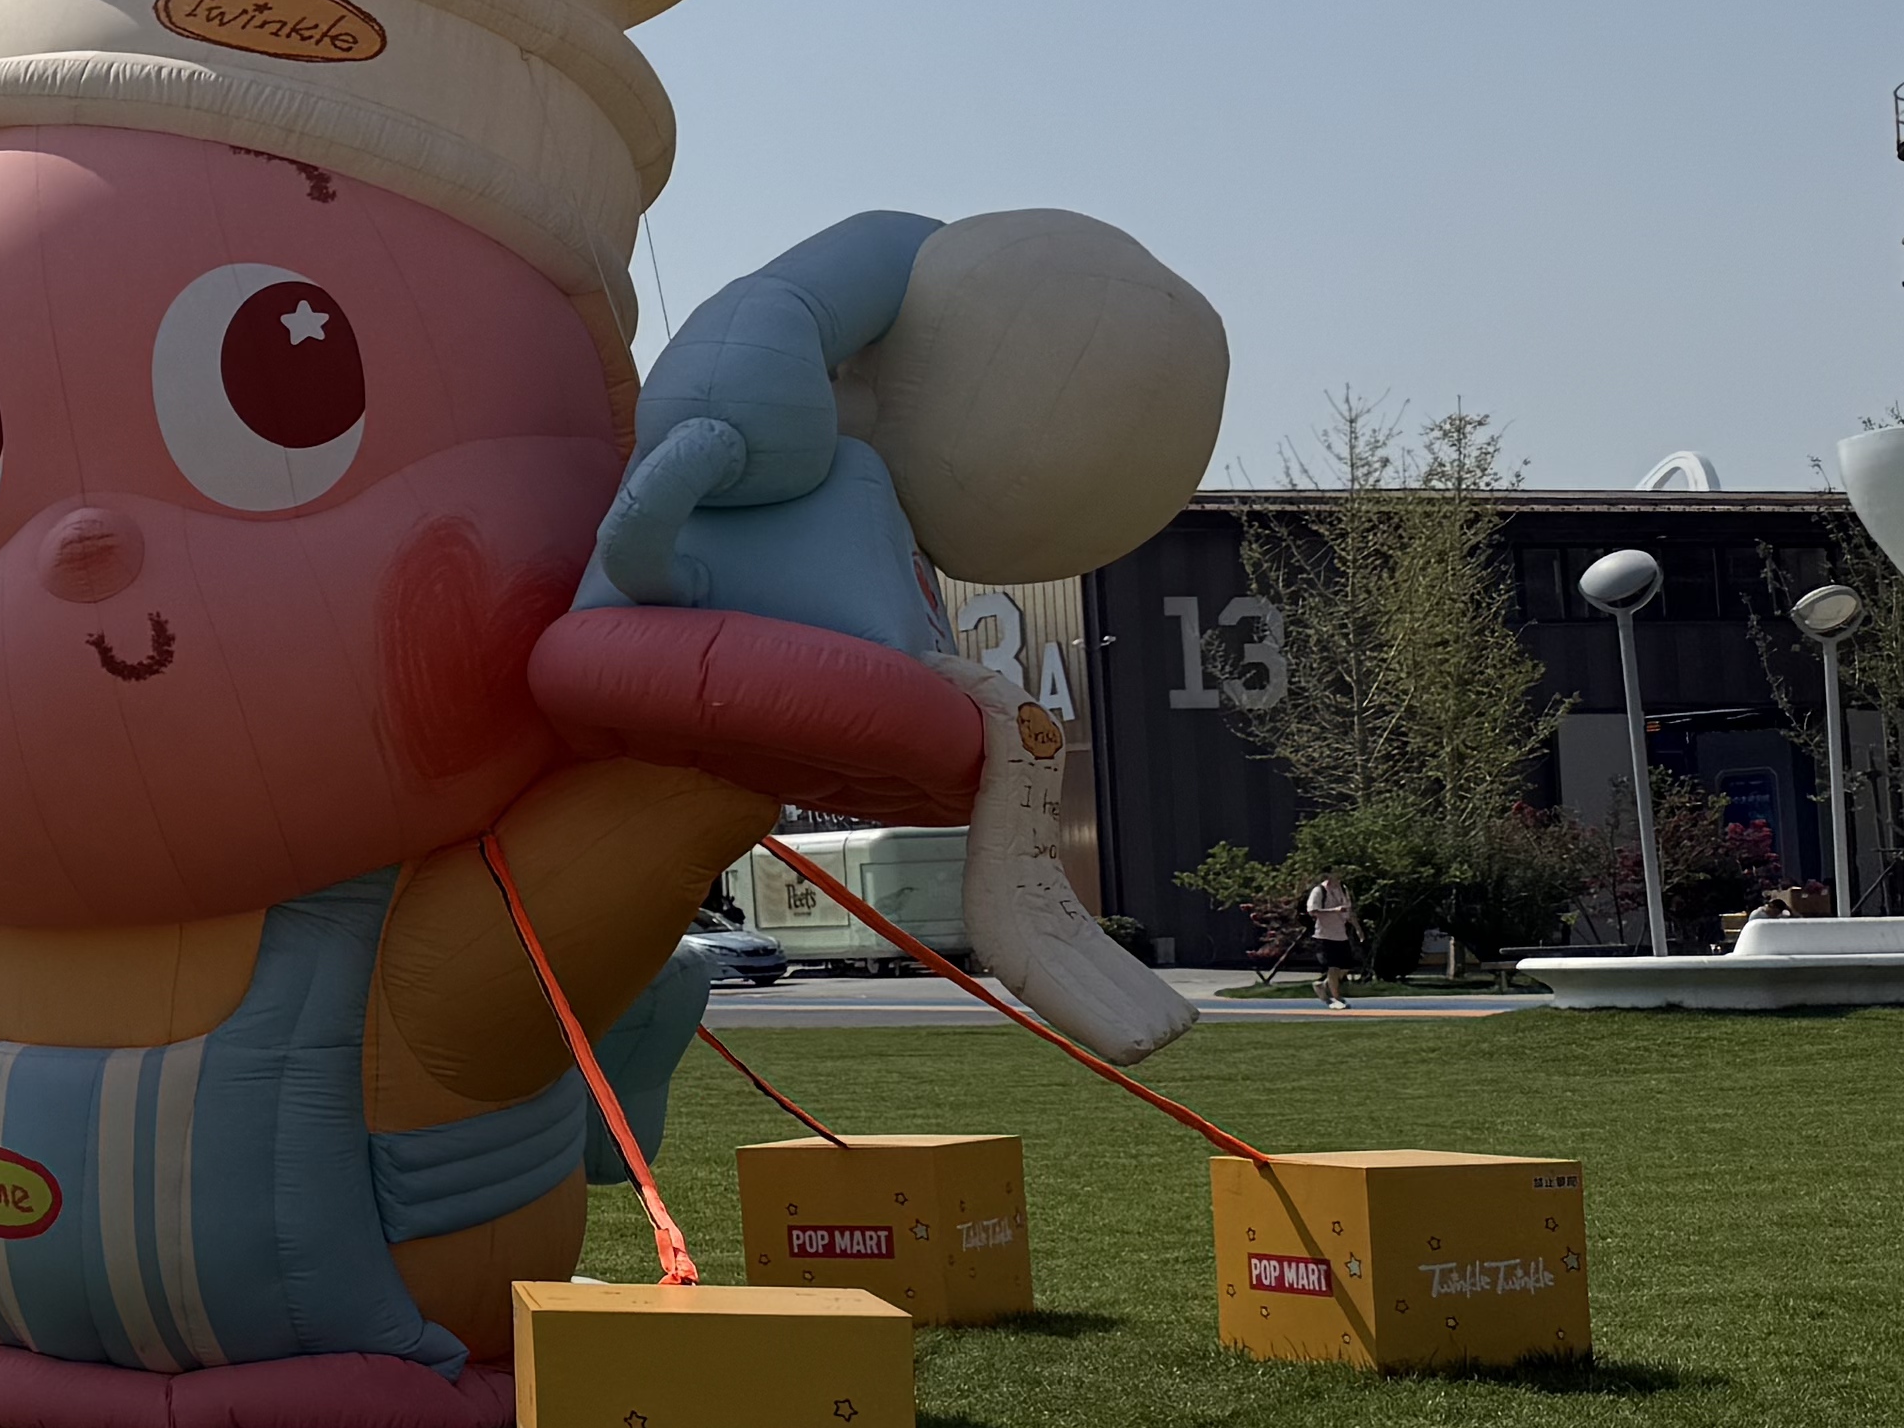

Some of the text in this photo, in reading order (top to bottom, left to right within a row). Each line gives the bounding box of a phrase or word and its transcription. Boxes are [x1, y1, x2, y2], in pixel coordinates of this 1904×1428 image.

[1164, 596, 1288, 710] 13
[792, 1230, 889, 1255] POP MART
[1251, 1258, 1327, 1292] POP MART
[1418, 1257, 1555, 1298] Twinkle Twinkle
